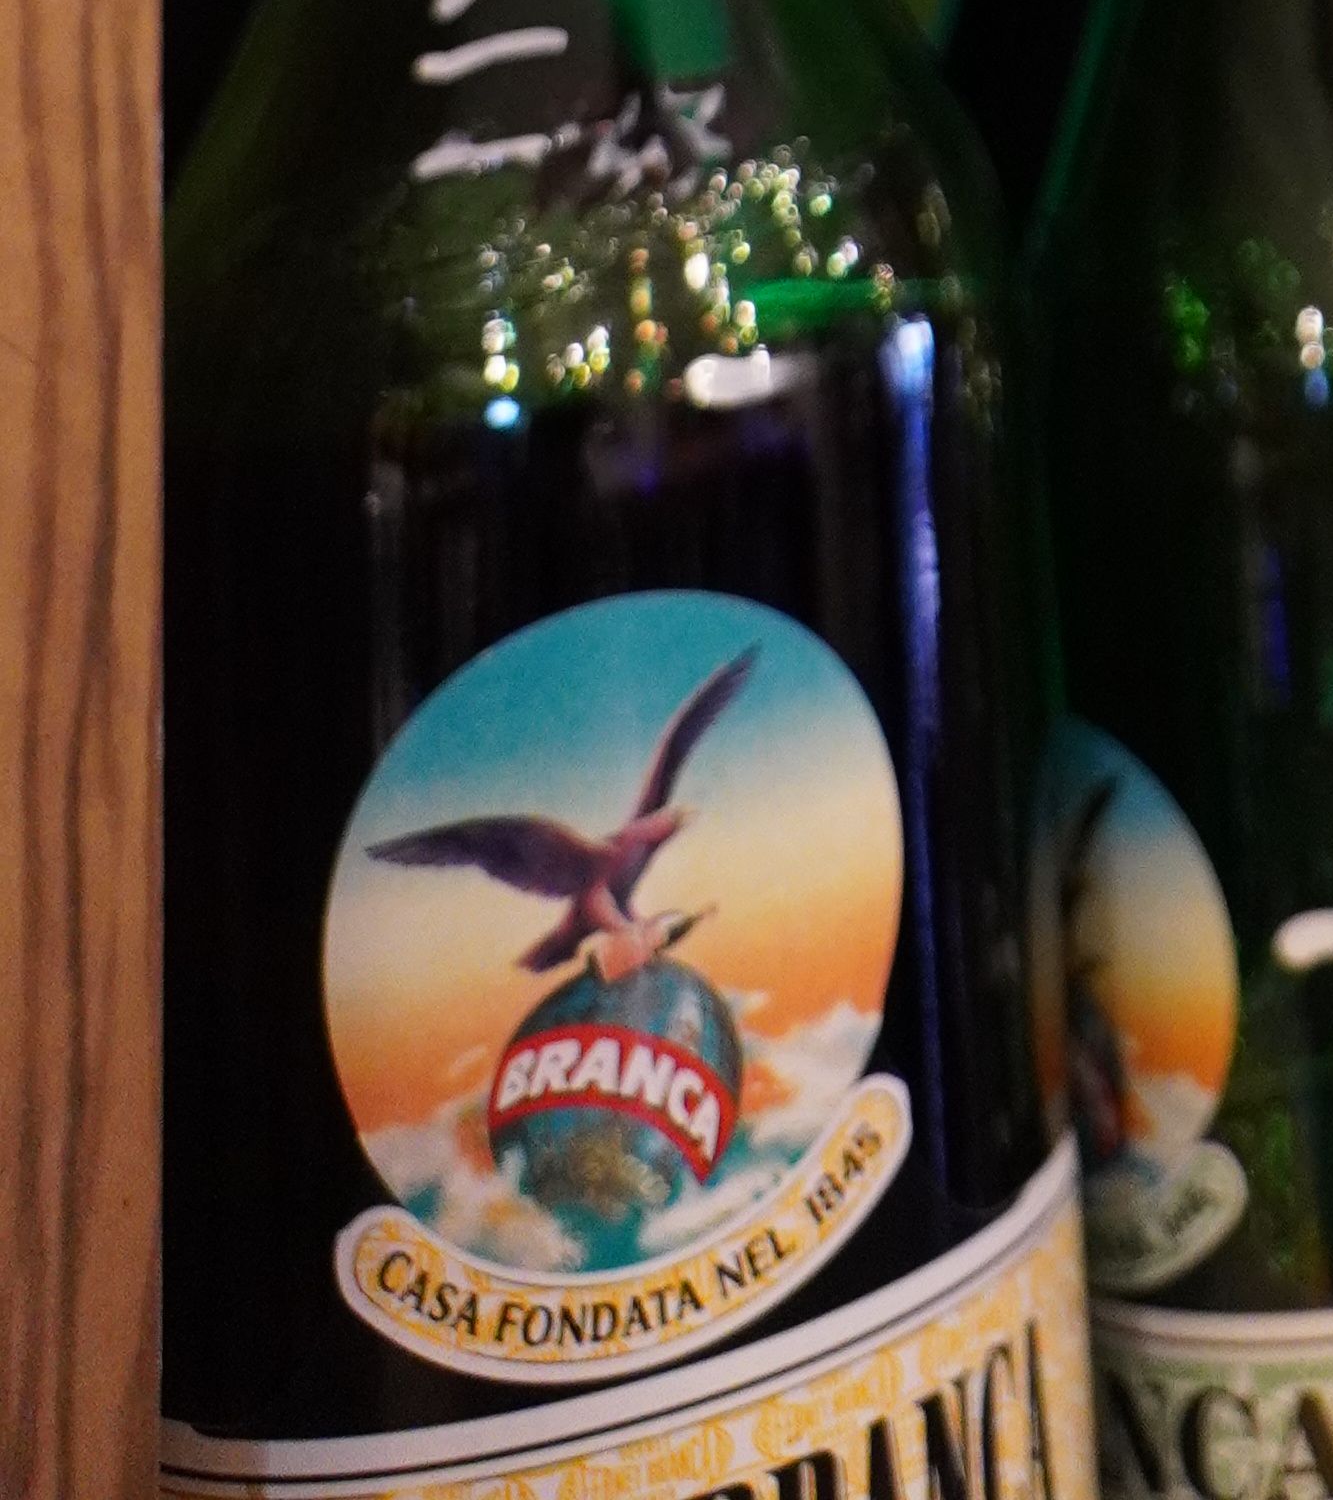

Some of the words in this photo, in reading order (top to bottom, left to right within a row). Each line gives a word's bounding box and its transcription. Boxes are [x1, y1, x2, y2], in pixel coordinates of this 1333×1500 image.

[495, 1036, 723, 1165] BRANCA
[376, 1248, 482, 1342] CASA
[491, 1279, 707, 1348] FONDATA
[713, 1228, 798, 1298] NEL
[801, 1119, 888, 1227] 1845
